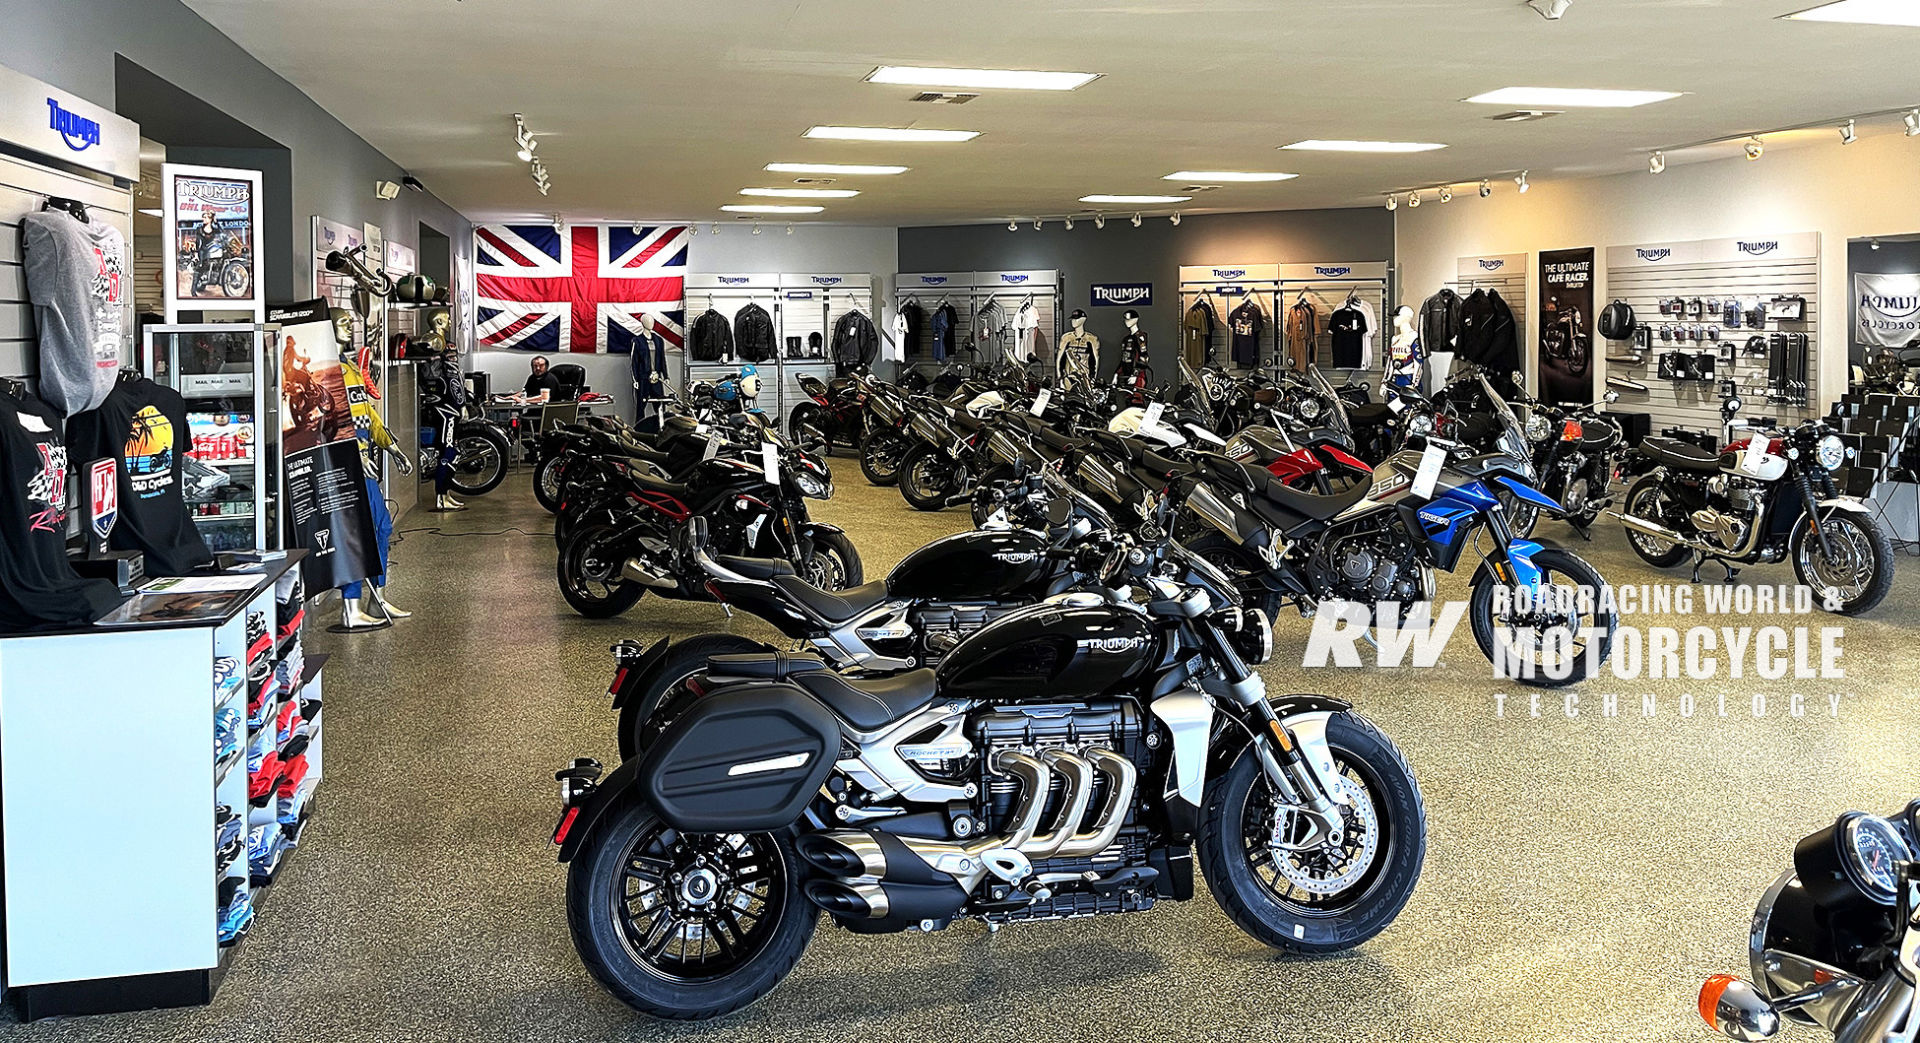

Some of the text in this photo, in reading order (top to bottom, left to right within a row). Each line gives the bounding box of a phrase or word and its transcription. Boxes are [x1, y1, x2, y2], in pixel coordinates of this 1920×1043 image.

[47, 97, 100, 151] TRIUMPH
[176, 179, 250, 205] TRIUMPH
[1737, 241, 1778, 255] TRIUMPH
[1636, 248, 1670, 261] TRIUMPH
[1479, 259, 1504, 271] TRIUMPH
[1545, 261, 1589, 273] THE ULTIMATE
[1213, 269, 1245, 279] TRIUMPH
[1314, 267, 1350, 277] TRIUMPH
[718, 276, 749, 285] TRIUMPH
[811, 276, 842, 285] TRIUMPH
[921, 276, 947, 285] TRIUMPH
[1001, 274, 1028, 284] TRIUMPH
[1094, 286, 1149, 304] TRIUMPH
[1420, 511, 1450, 526] TIGER
[997, 552, 1038, 564] TRIUMPH
[1088, 637, 1141, 653] TRIUMPH
